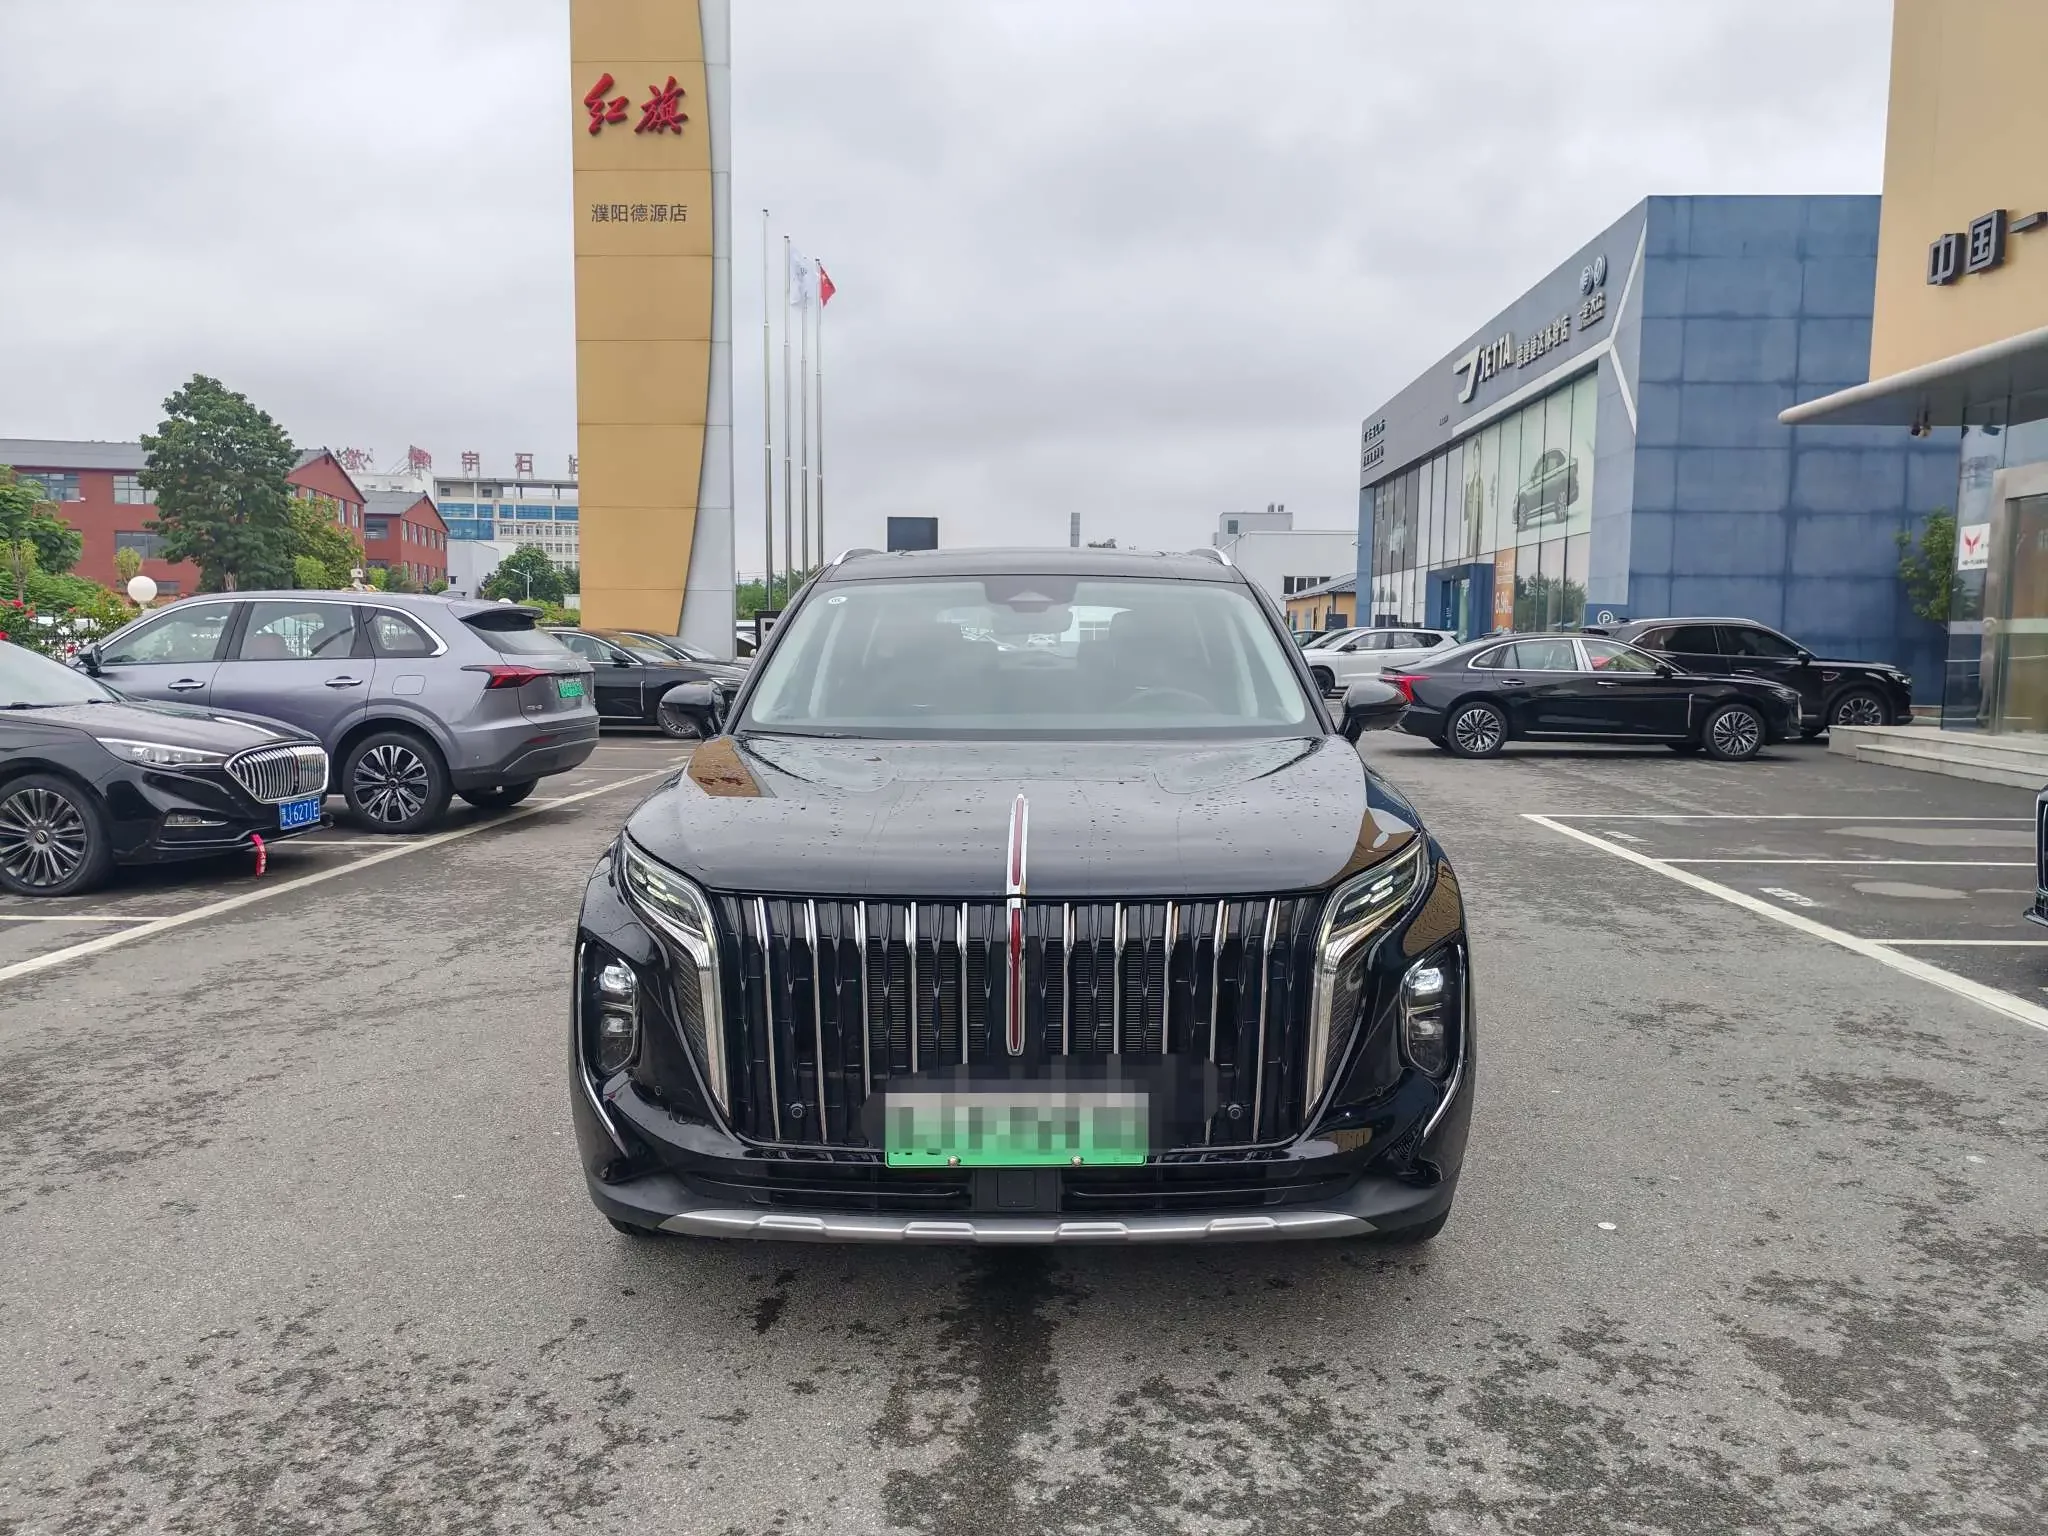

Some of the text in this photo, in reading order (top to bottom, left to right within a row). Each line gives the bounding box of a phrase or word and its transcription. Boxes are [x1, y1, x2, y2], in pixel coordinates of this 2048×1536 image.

[584, 73, 689, 136] 红旗
[591, 203, 688, 223] 濮阳德源店
[1926, 208, 2048, 287] 中国一
[1479, 332, 1514, 383] JETTA
